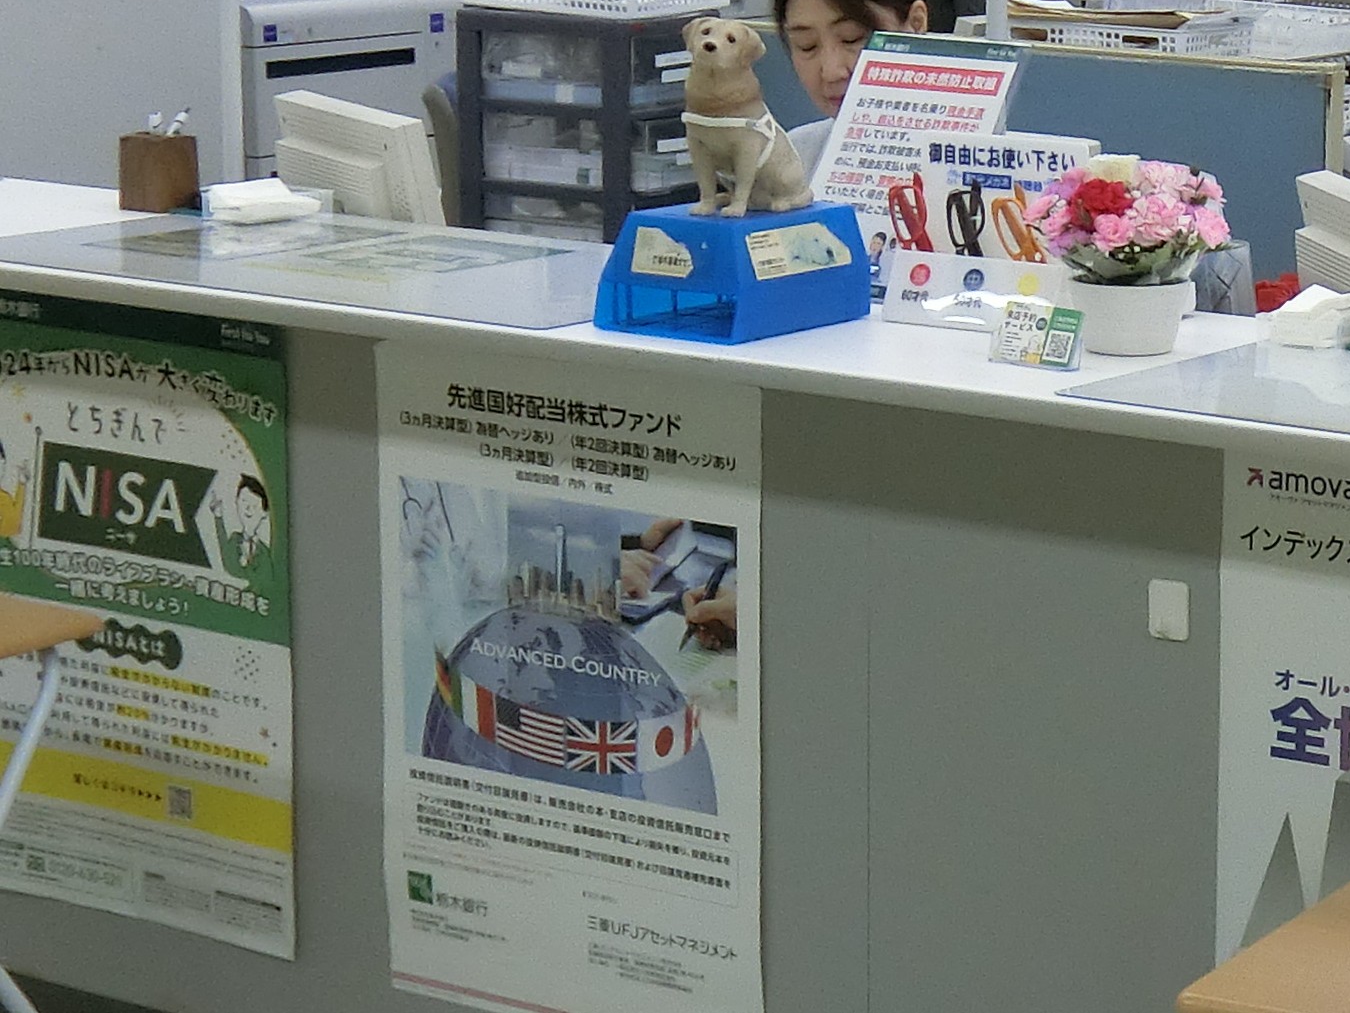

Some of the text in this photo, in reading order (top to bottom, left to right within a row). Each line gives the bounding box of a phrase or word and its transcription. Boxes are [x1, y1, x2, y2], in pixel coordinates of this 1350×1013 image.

[929, 142, 1076, 173] 御自由にお使い下さい
[447, 383, 681, 438] 先進国好配当株式ファンド
[54, 460, 187, 534] NISA
[468, 636, 662, 687] ADVANCED COUNTRY
[586, 915, 738, 961] 三菱UFJアセットマネジメント
